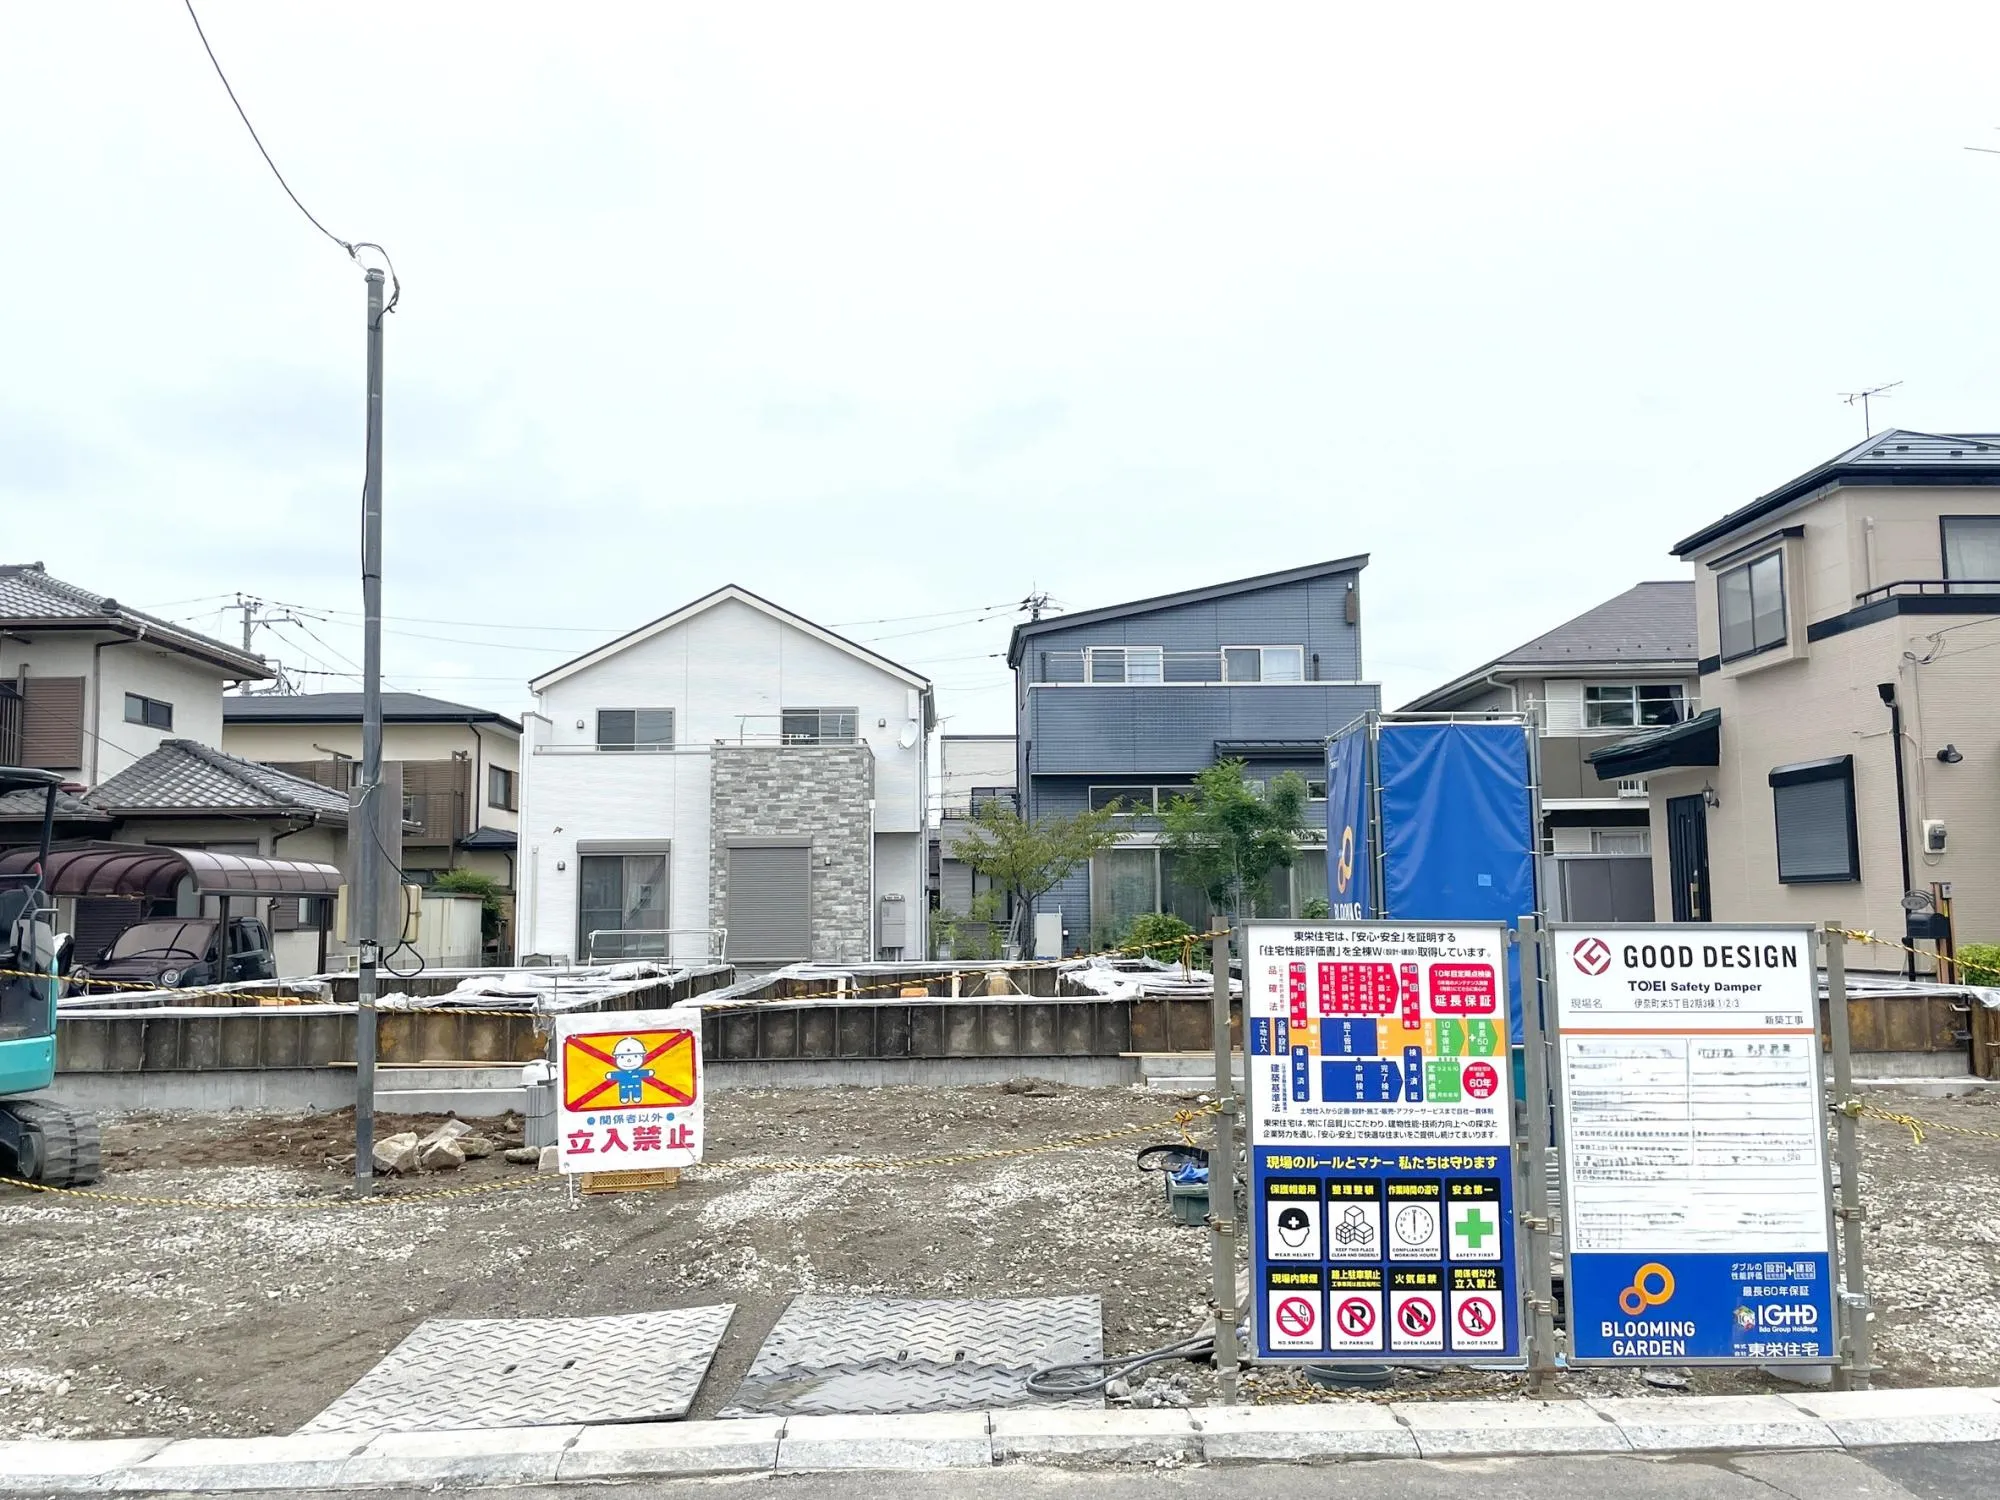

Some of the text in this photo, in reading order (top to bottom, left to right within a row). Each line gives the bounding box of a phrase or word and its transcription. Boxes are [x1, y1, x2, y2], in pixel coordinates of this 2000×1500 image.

[1623, 944, 1798, 969] GOOD DESIGN
[1268, 965, 1278, 1012] 品確法
[1670, 981, 1711, 994] Safety
[1714, 982, 1762, 993] Damper
[1434, 995, 1492, 1007] 延長保証
[1570, 998, 1603, 1009] 現場名
[1765, 1015, 1804, 1025] 新築工事
[1260, 1020, 1268, 1053] 土地仕入
[1343, 1021, 1352, 1053] 施工管理
[1441, 1021, 1450, 1054] 10年保証
[1295, 1048, 1306, 1100] 確認済証
[1409, 1049, 1418, 1100] 検査済証
[1271, 1063, 1281, 1113] 建築基準法
[1355, 1065, 1364, 1100] 中間検査
[1380, 1064, 1390, 1100] 完了検査
[1469, 1078, 1492, 1089] 60年
[599, 1112, 663, 1126] 関係者以外
[566, 1123, 696, 1155] 立入禁止
[1266, 1155, 1498, 1170] 現場のルールとマナー 私たちは守ります
[1331, 1184, 1374, 1195] 整理整頓
[1451, 1184, 1494, 1195] 安全第一
[1731, 1263, 1763, 1271] ダブルの
[1766, 1263, 1813, 1273] 設計 建設
[1271, 1273, 1319, 1285] 現場内禁煙
[1394, 1273, 1437, 1284] 火気厳禁
[1454, 1269, 1496, 1279] 関係者以外
[1731, 1272, 1763, 1281] 性能評価
[1455, 1278, 1497, 1289] 立入禁止
[1742, 1285, 1810, 1297] 最長60年保証
[1601, 1321, 1696, 1337] BLOOMING
[1771, 1326, 1791, 1334] Group
[1792, 1326, 1819, 1334] Holdings
[1612, 1340, 1686, 1356] GARDEN
[1747, 1342, 1820, 1357] 東栄住宅
